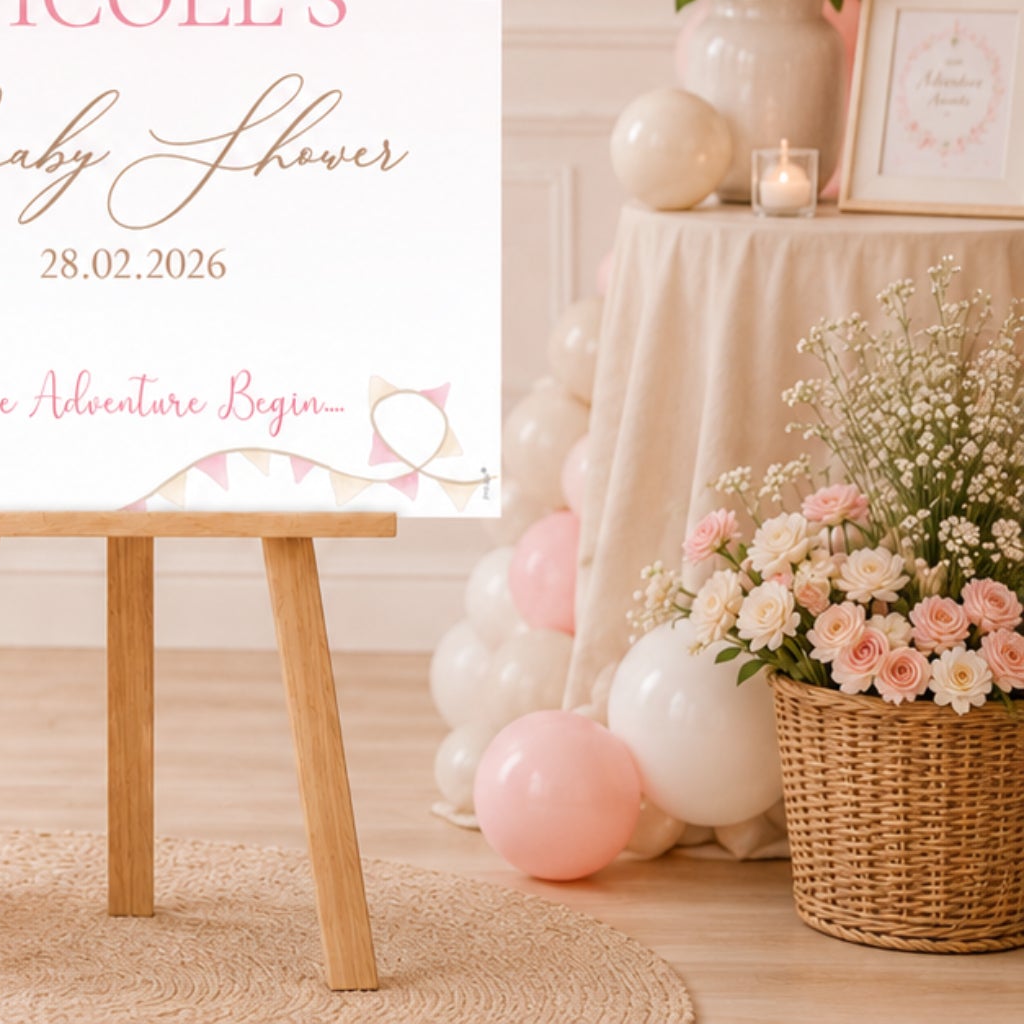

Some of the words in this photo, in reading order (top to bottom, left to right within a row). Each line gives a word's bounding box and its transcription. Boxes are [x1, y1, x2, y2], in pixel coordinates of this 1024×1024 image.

[106, 73, 409, 230] Shower
[40, 247, 227, 280] 28.02.2026
[28, 369, 207, 420] Adventure
